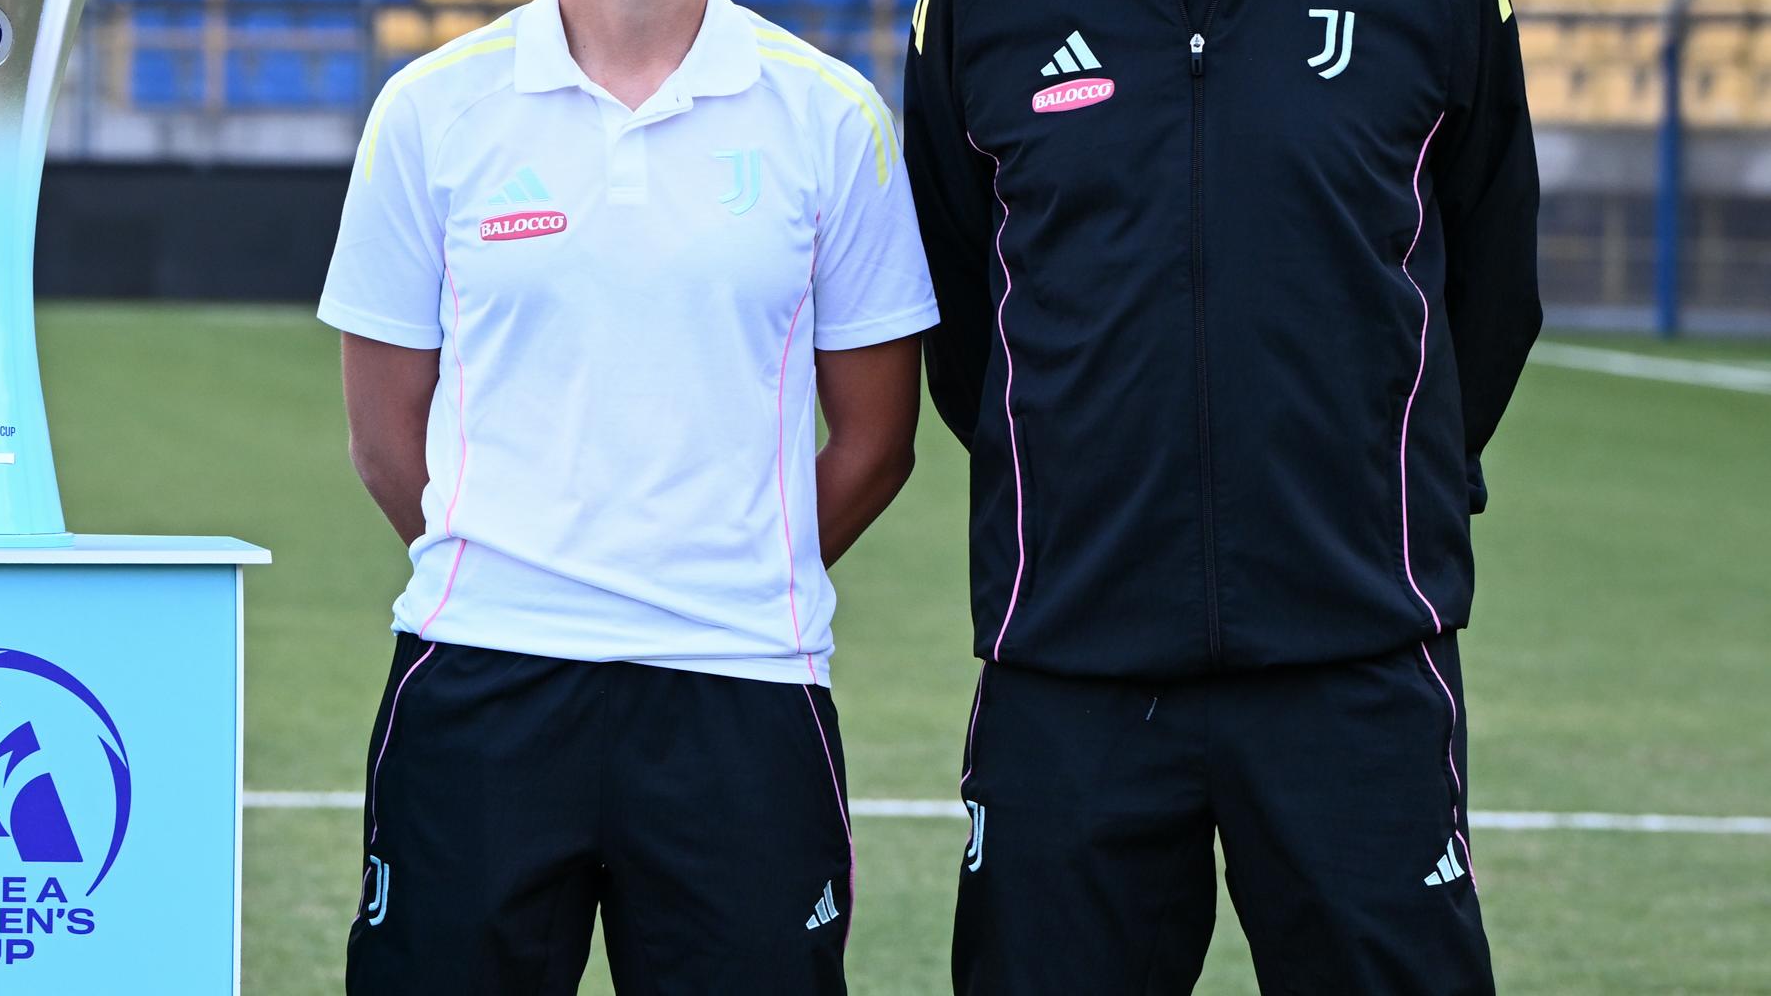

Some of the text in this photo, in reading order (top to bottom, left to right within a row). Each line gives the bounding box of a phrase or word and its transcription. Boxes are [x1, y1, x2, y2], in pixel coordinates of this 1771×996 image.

[1034, 82, 1112, 110] BALOCCO
[480, 215, 565, 238] BALOCCO
[0, 425, 16, 437] CUP
[35, 876, 69, 904] A
